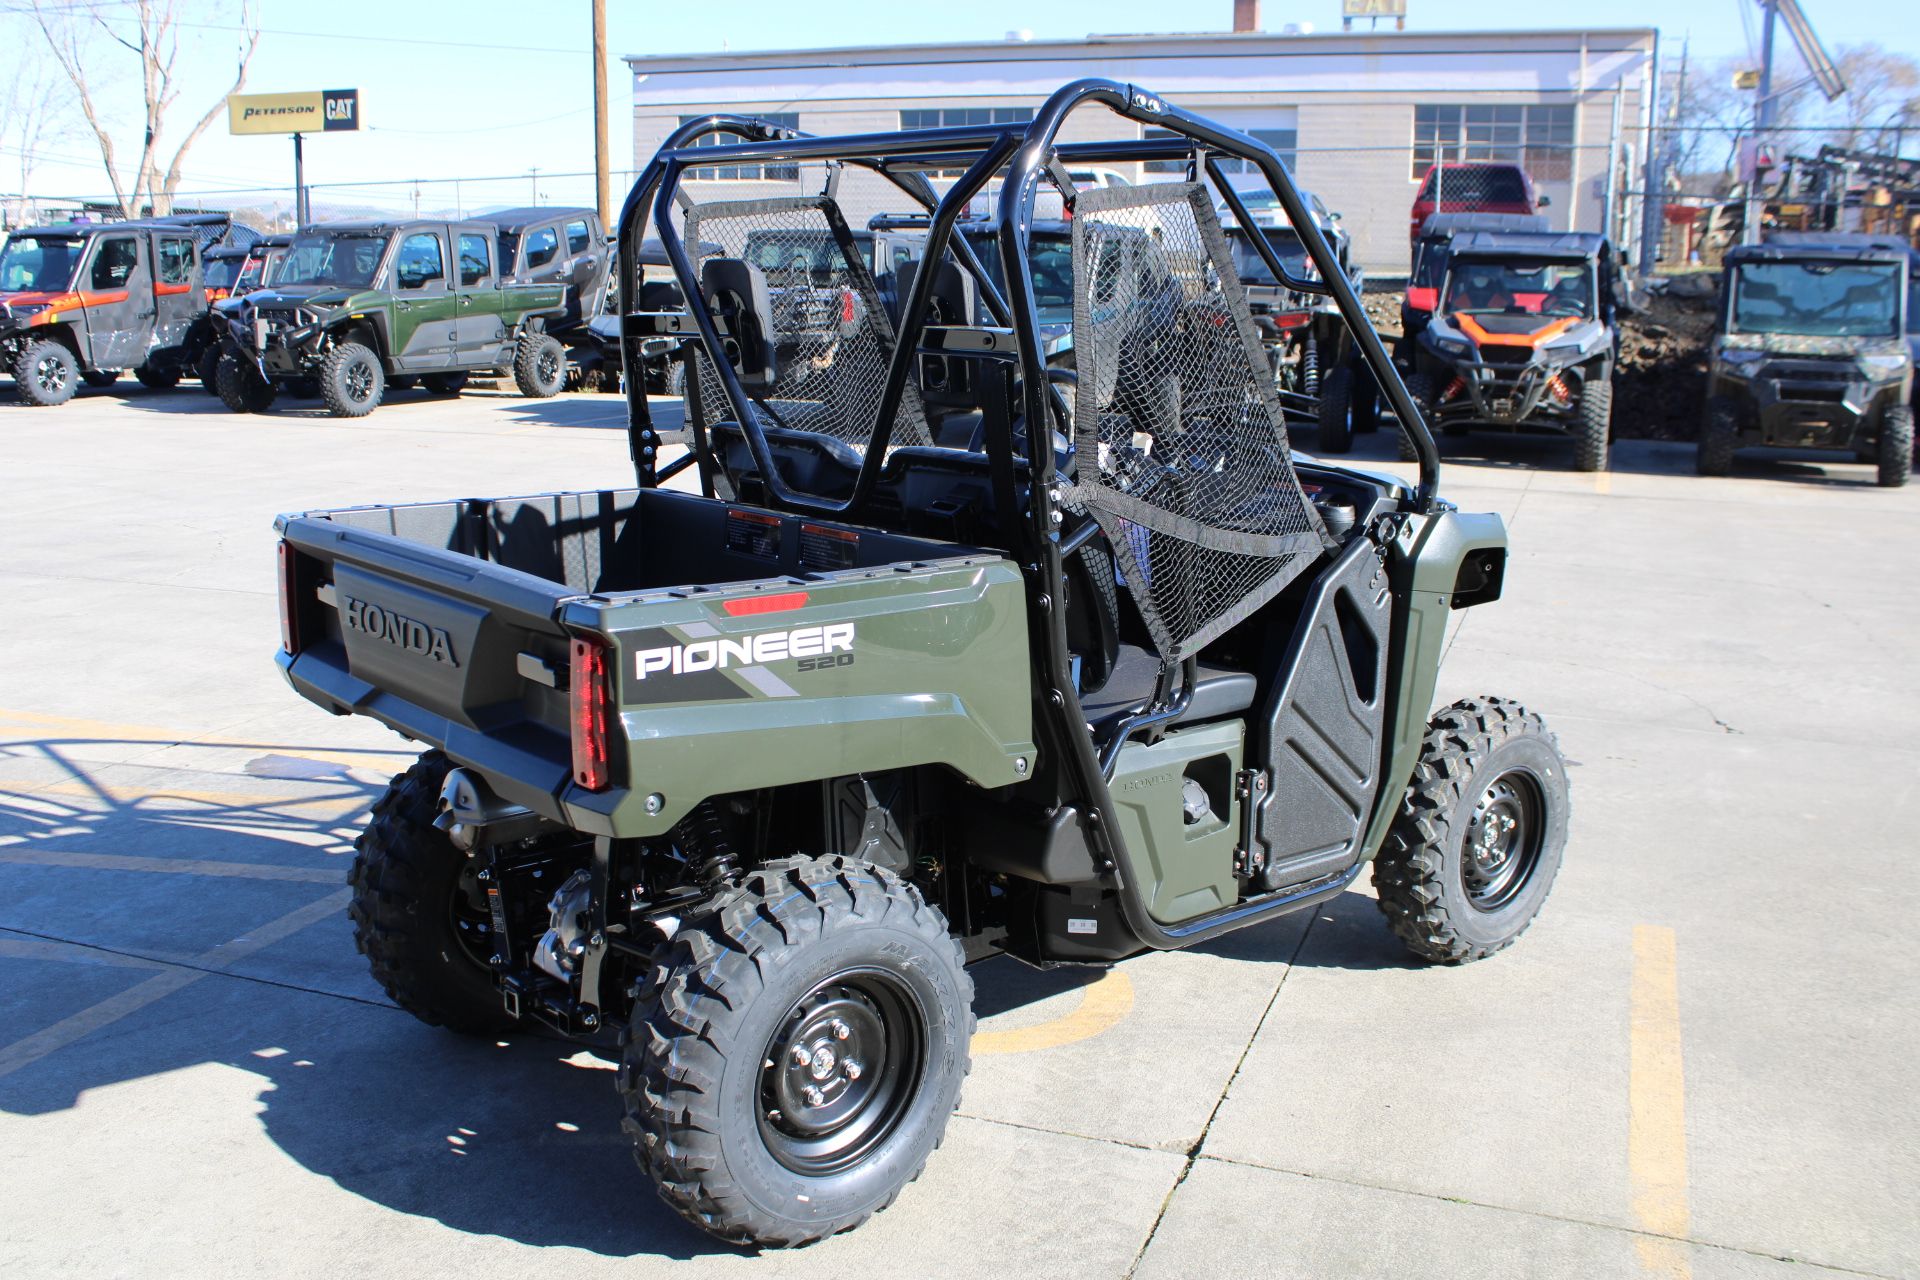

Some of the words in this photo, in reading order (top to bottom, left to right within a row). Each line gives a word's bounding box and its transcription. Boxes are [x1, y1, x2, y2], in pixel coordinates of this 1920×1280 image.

[243, 106, 315, 120] PETERSON
[326, 99, 354, 120] CAT
[343, 595, 461, 668] HONDA
[635, 622, 855, 680] PIONEER
[797, 653, 855, 673] 520
[879, 941, 956, 1077] MAXXIS
